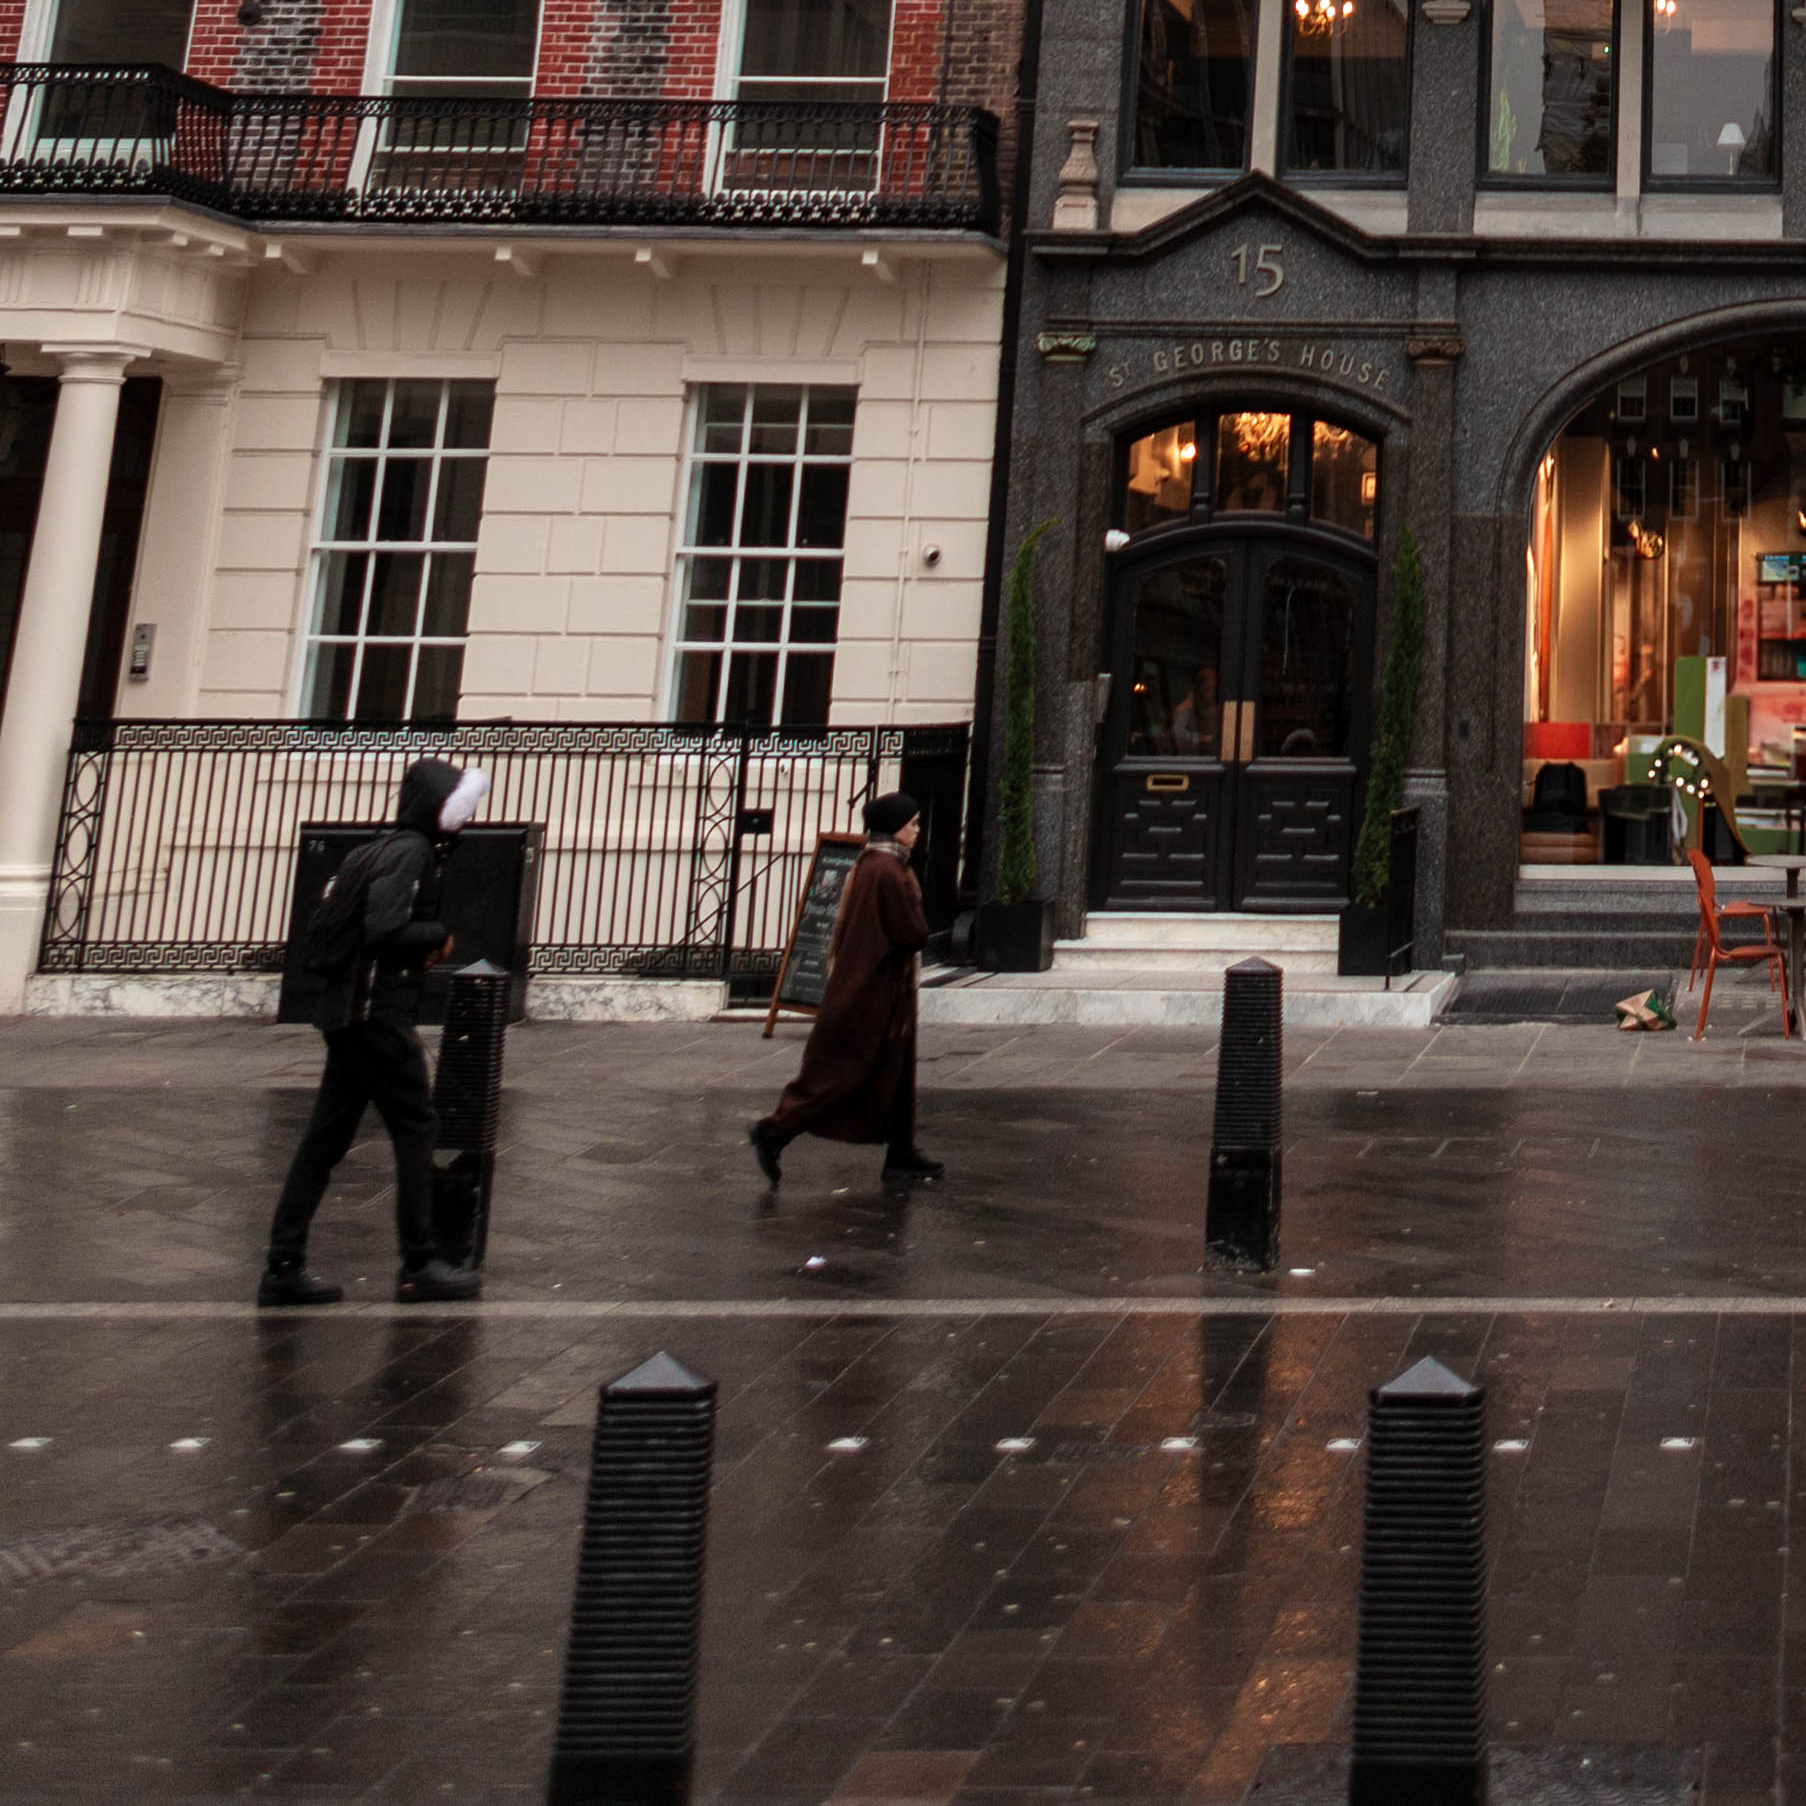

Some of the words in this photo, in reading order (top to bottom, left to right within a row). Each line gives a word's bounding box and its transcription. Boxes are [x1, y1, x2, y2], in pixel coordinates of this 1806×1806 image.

[1230, 242, 1285, 299] 15
[1153, 338, 1282, 372] GEORGE'S
[1300, 344, 1392, 391] HOUSE
